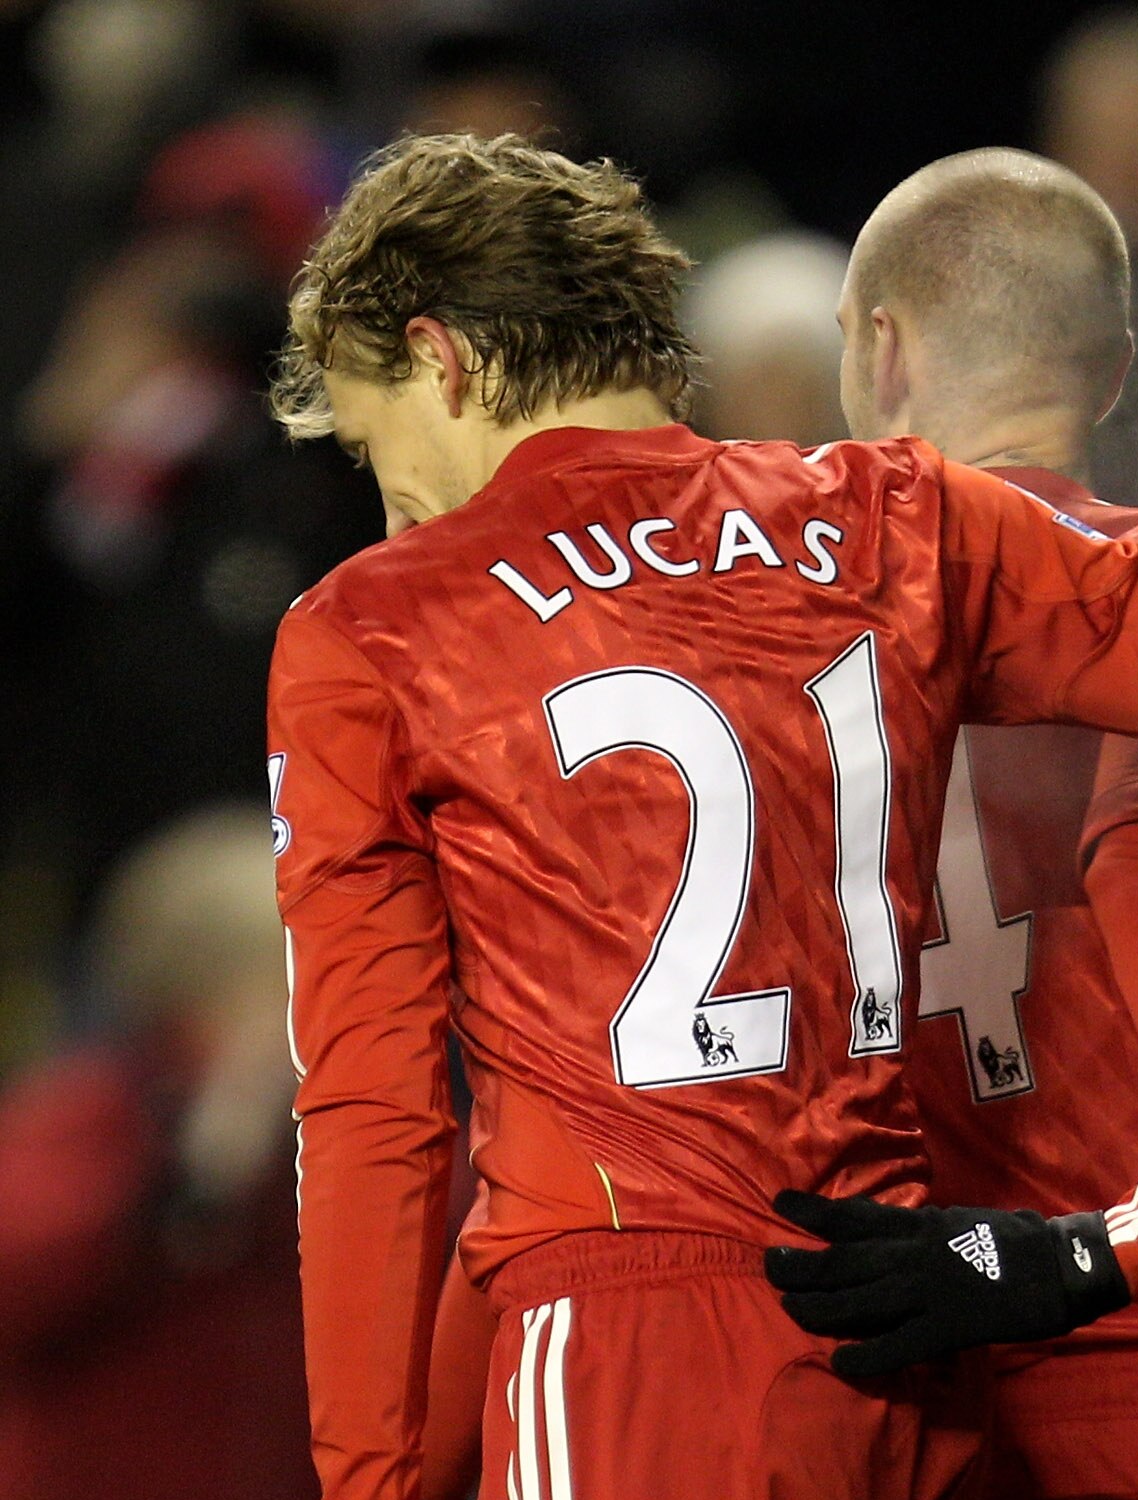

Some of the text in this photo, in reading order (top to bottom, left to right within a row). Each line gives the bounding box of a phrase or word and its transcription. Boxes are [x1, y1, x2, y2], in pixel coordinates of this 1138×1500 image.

[486, 508, 844, 624] LUCAS
[541, 629, 903, 1090] 21
[974, 1222, 1001, 1281] adidas
